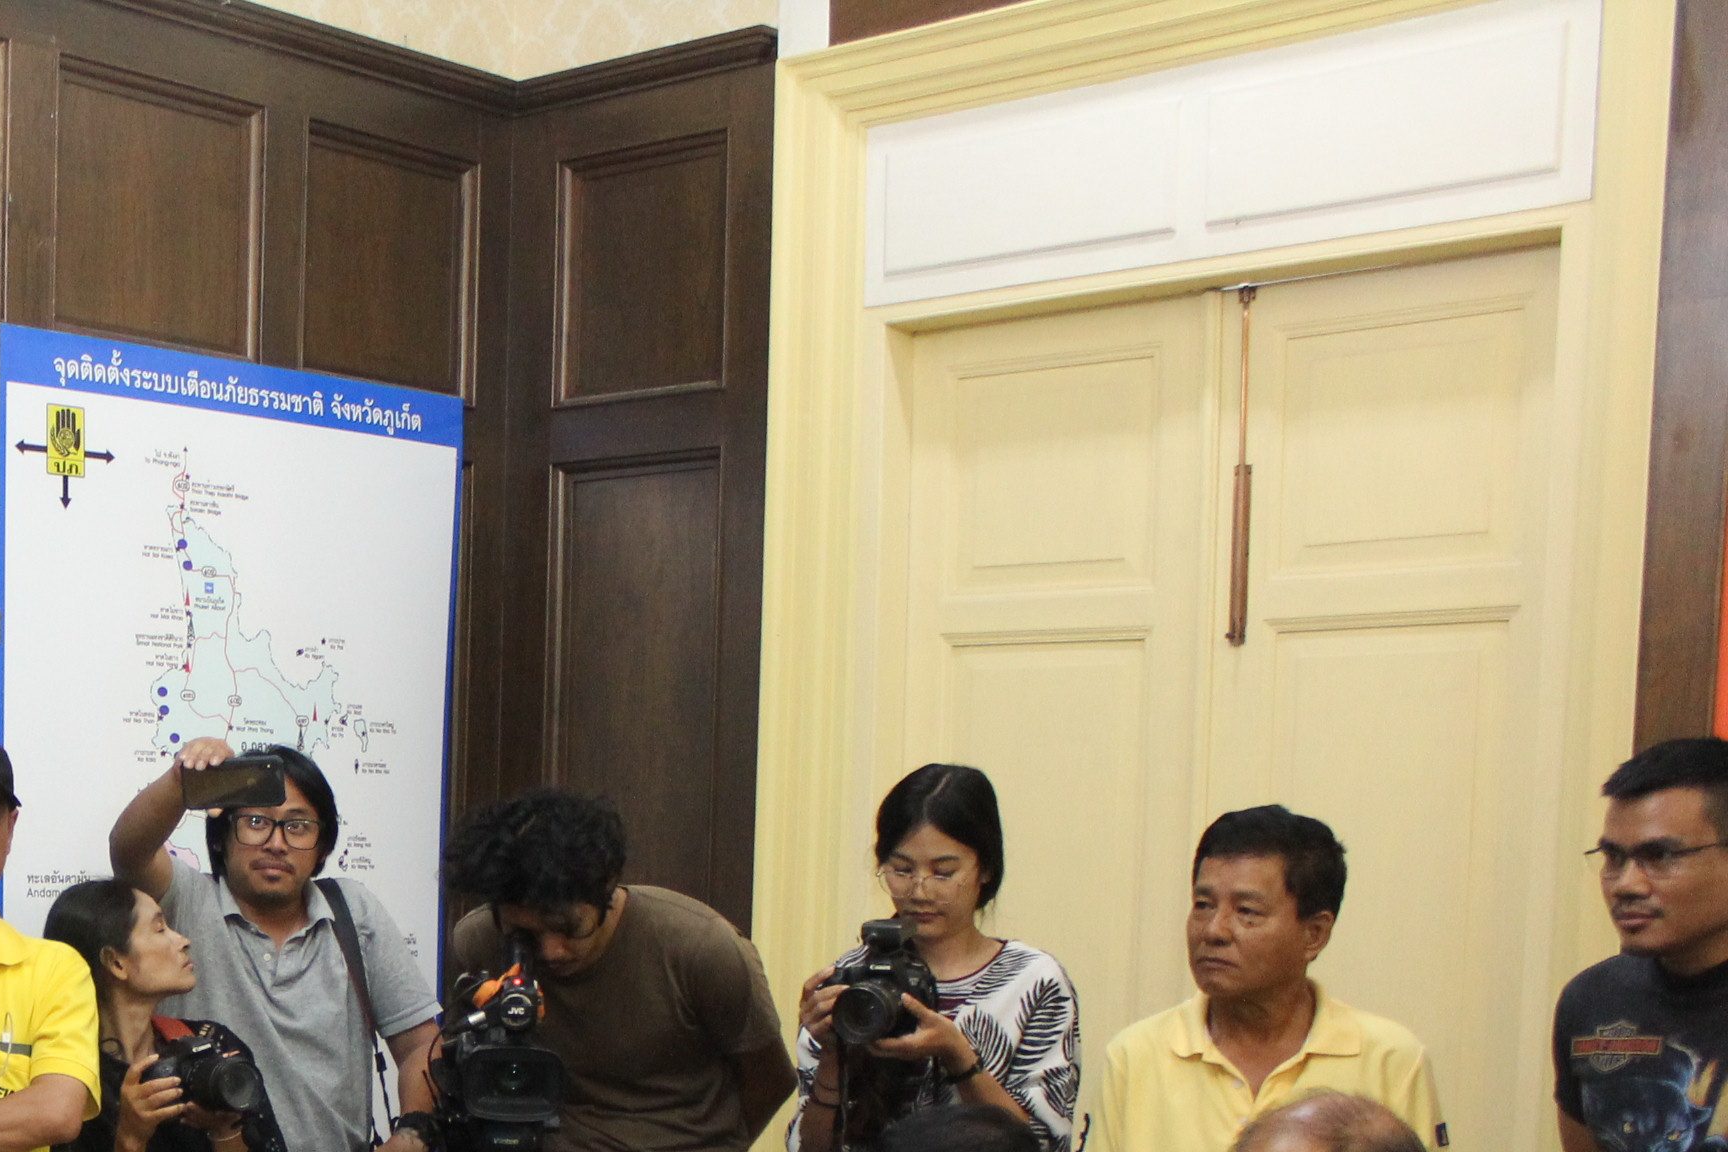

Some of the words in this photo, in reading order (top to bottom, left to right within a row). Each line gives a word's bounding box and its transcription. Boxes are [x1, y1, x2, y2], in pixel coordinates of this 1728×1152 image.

[53, 350, 324, 418] จุดติดตั้งระบบเตือนภัยธรรมชาติ
[330, 394, 423, 435] จังหวัดภูเก็ต
[26, 887, 61, 898] Andam
[507, 1006, 525, 1015] JVC
